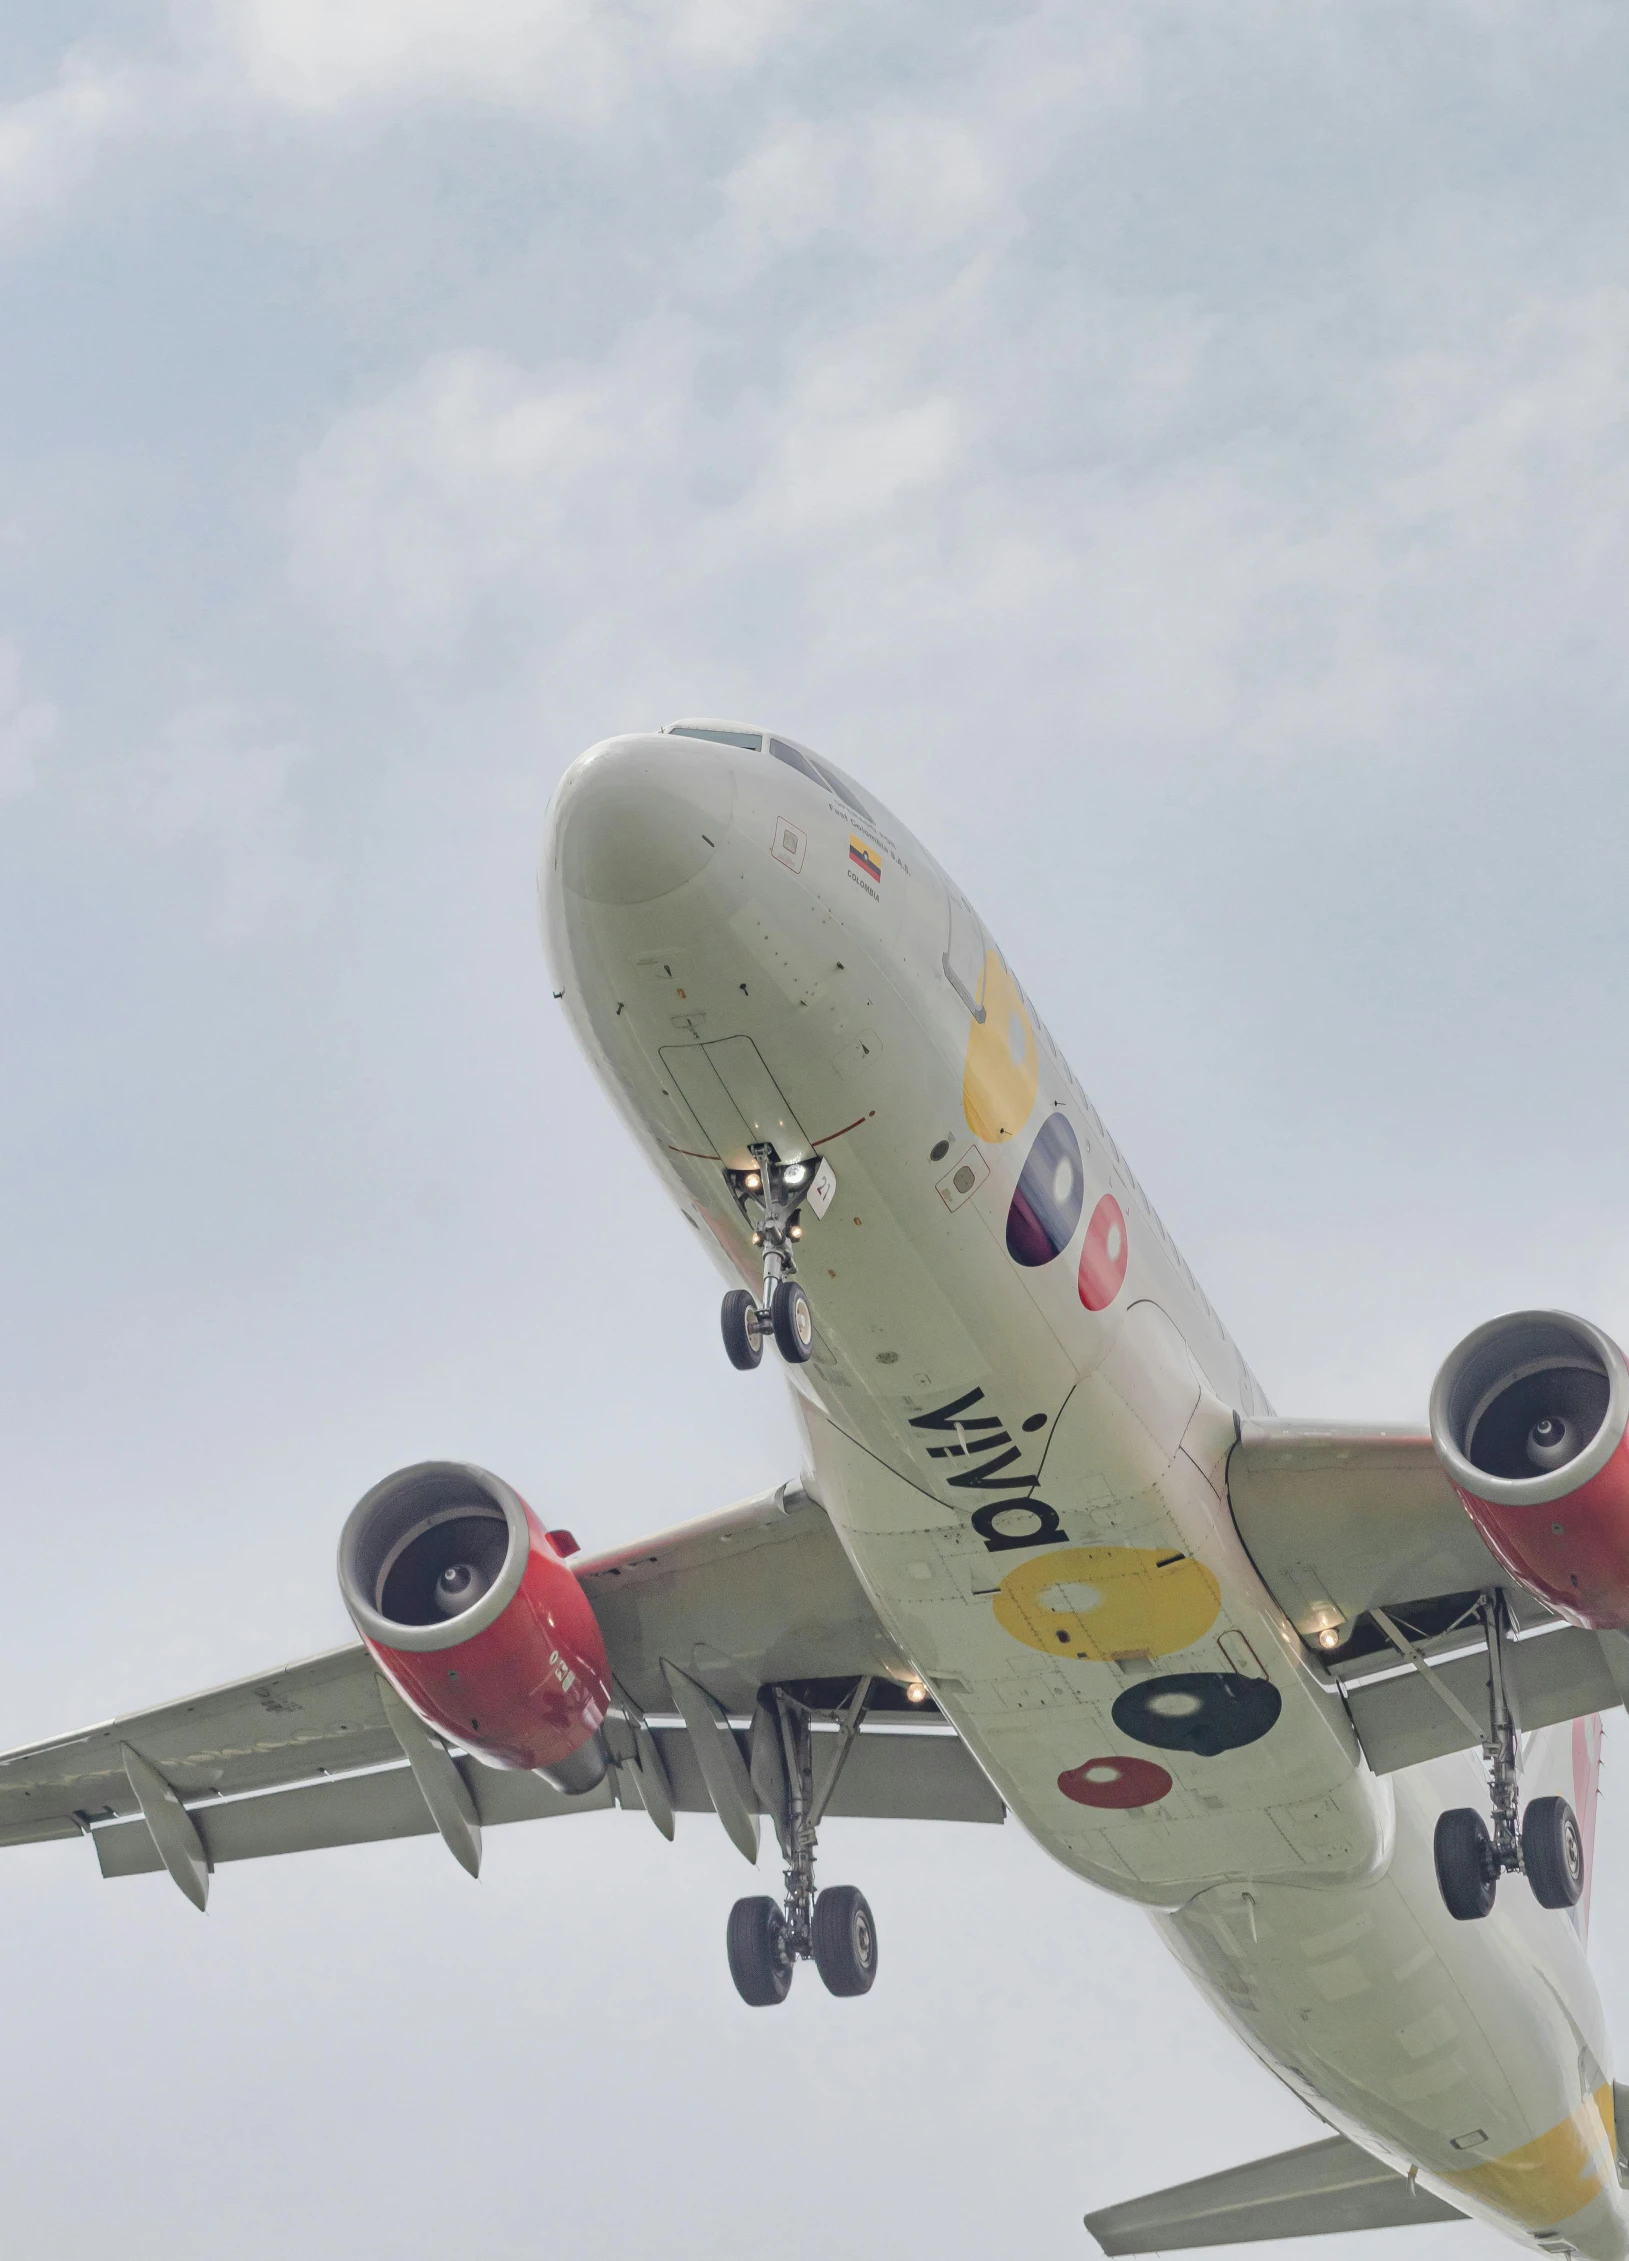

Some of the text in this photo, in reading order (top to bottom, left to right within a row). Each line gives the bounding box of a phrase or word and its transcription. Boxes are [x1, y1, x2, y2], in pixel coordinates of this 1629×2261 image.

[828, 803, 849, 822] Fast
[850, 818, 889, 854] Colombia
[890, 850, 911, 876] S.A.S.
[847, 869, 880, 903] COLOMBIA
[816, 1175, 831, 1202] 21
[908, 1386, 1070, 1553] viva
